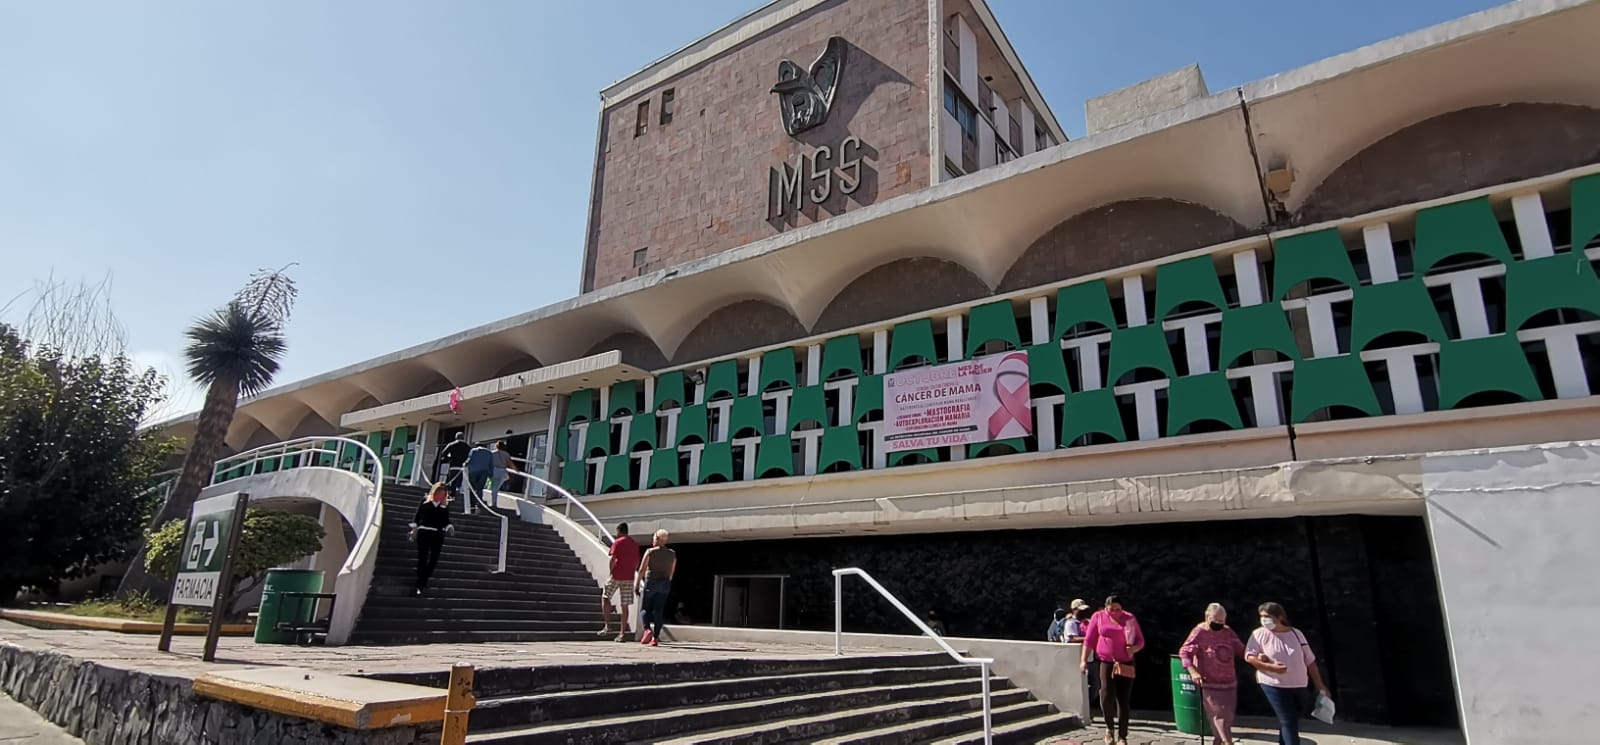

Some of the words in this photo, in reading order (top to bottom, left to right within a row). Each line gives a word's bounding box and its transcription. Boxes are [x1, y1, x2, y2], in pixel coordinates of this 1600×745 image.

[766, 135, 863, 221] IMSS
[969, 367, 992, 376] MUJER
[895, 390, 932, 404] CÁNCER
[934, 388, 947, 398] DE
[949, 383, 982, 396] MAMA
[944, 411, 971, 421] MAMARIA
[892, 438, 925, 449] SALVA
[927, 436, 940, 445] TU
[942, 434, 968, 444] VIDA
[175, 578, 214, 599] FARMACIA
